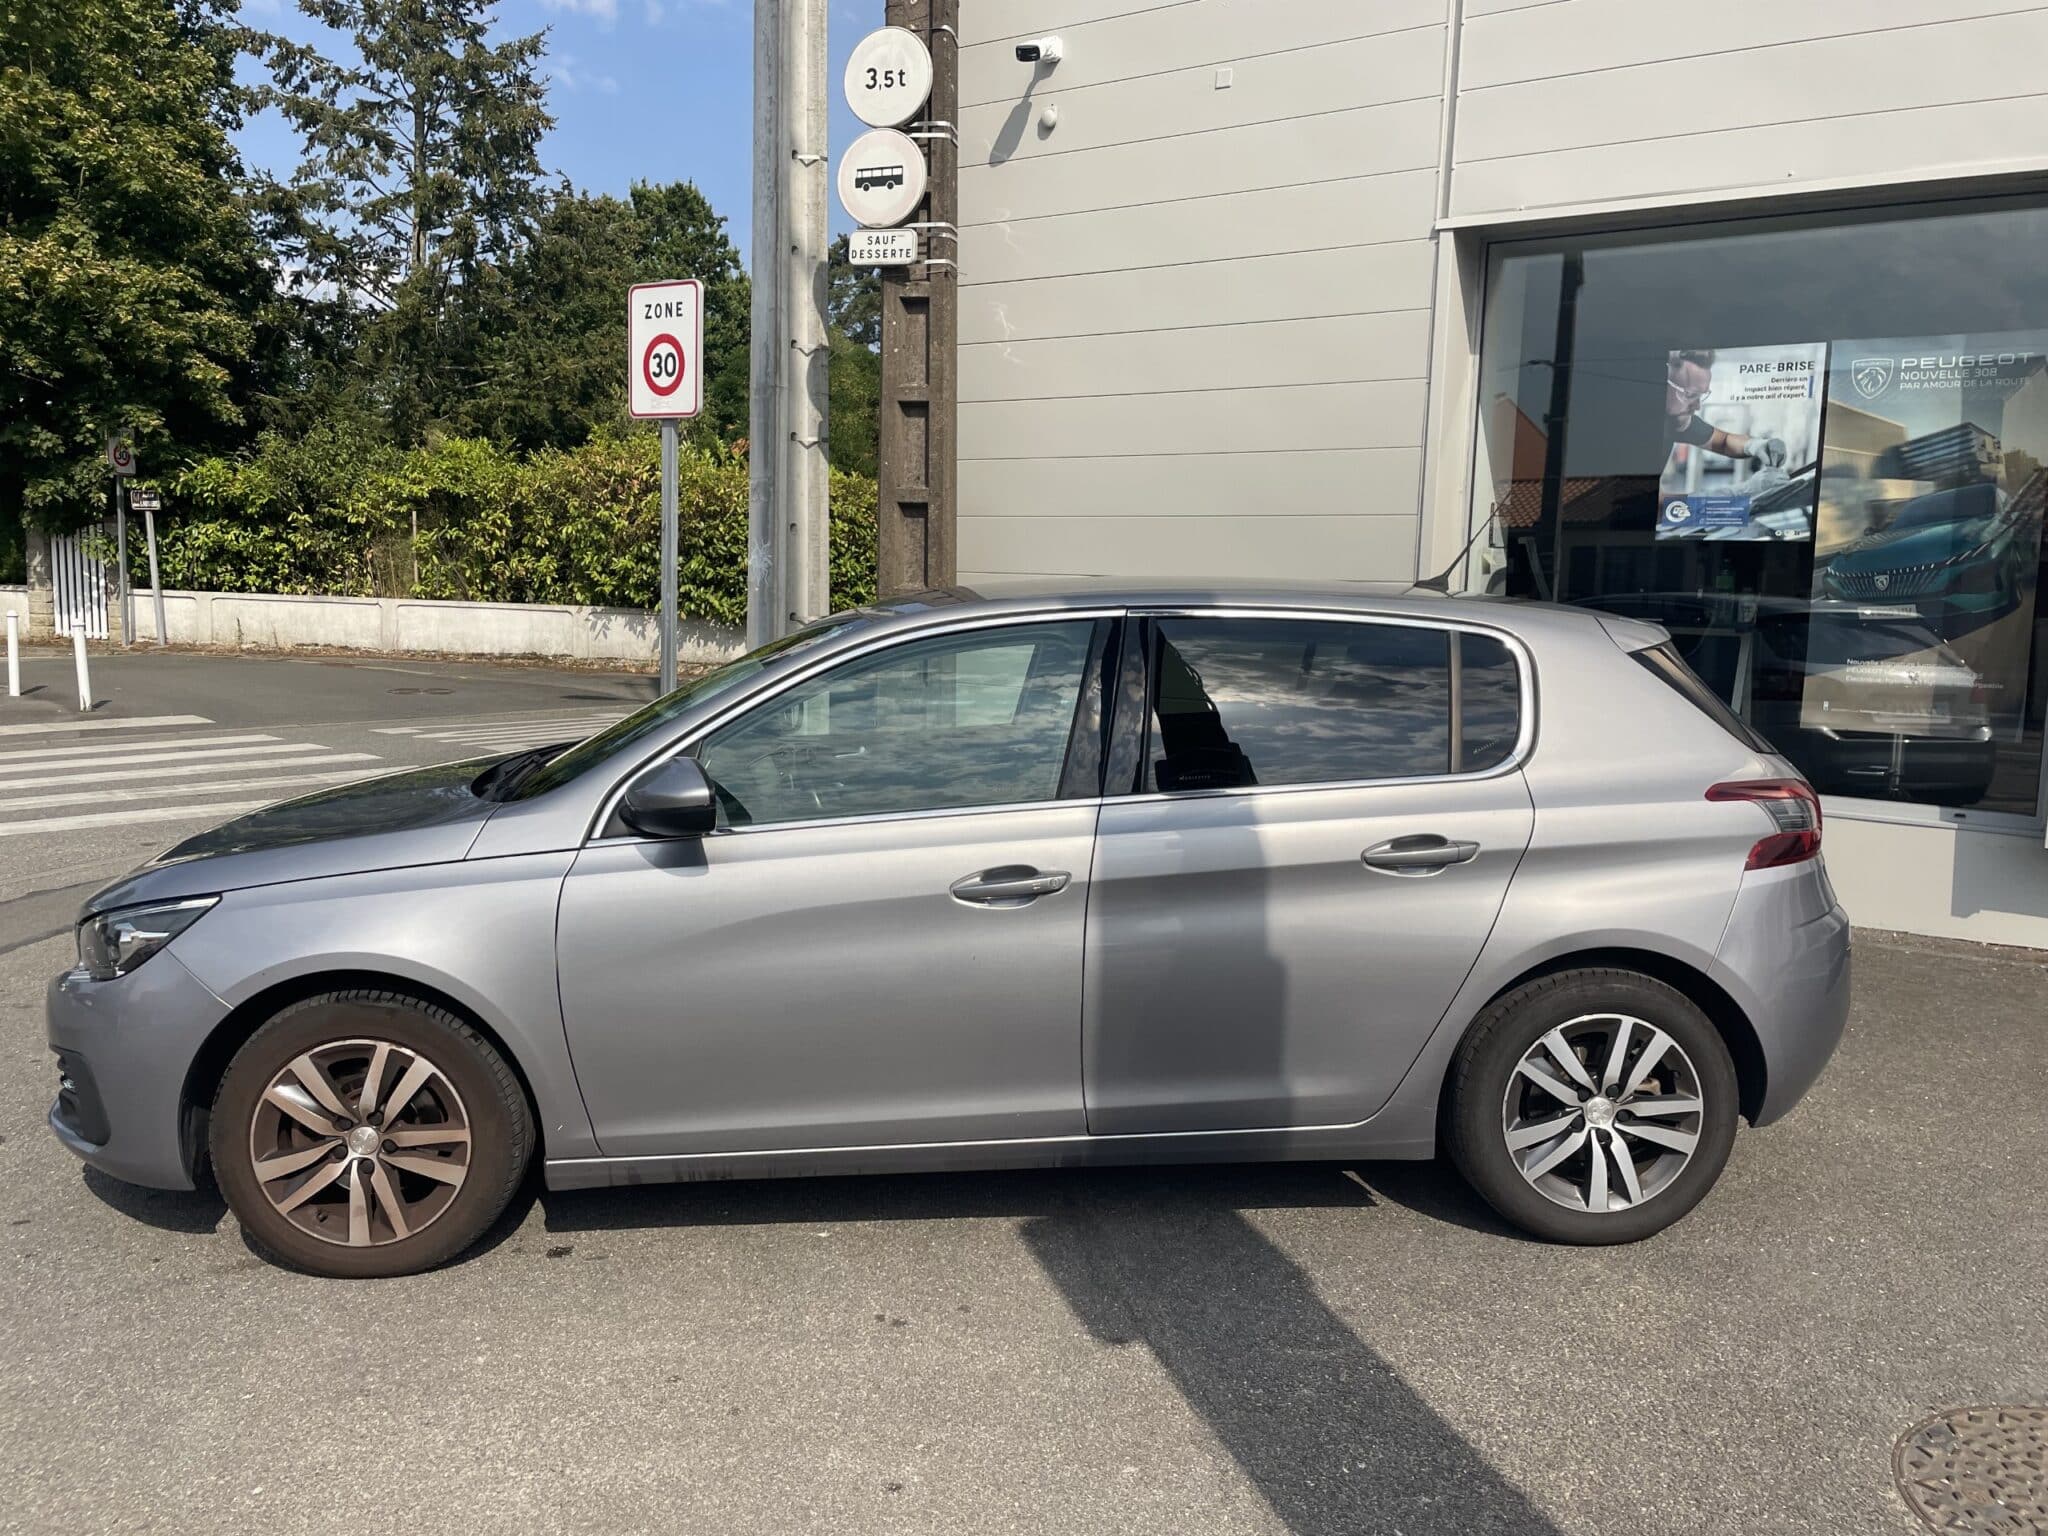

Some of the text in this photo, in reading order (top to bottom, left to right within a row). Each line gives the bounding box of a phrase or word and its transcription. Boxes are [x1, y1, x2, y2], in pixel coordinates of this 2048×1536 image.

[865, 67, 906, 91] 3,5 t
[867, 235, 897, 246] SAUF
[851, 248, 912, 259] DESSERTE
[644, 301, 683, 319] ZONE
[652, 352, 677, 378] 30
[1739, 360, 1815, 374] PARE-BRISE
[1901, 352, 2035, 370] PEUGEOT
[1900, 367, 1998, 381] NOUVELLE 308
[1900, 381, 1921, 390] PAR
[1923, 380, 1960, 390] AMOUR
[1963, 379, 1977, 387] DE
[1980, 378, 1992, 387] LA
